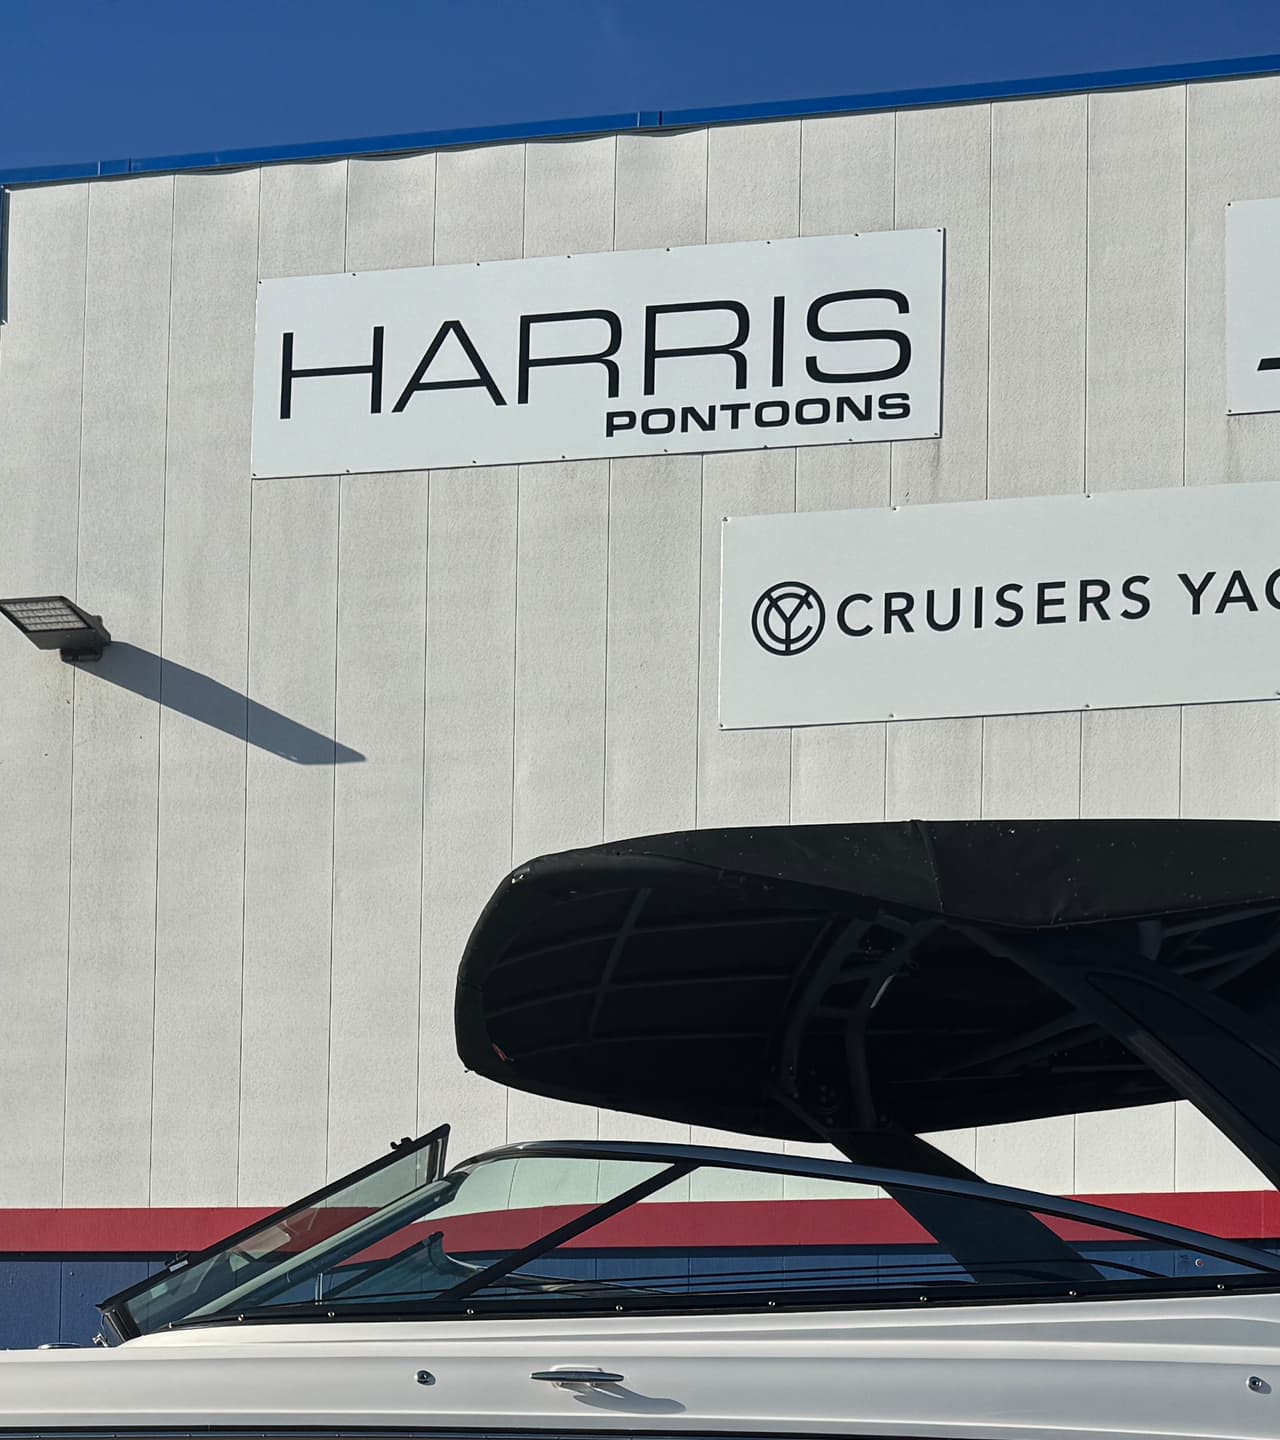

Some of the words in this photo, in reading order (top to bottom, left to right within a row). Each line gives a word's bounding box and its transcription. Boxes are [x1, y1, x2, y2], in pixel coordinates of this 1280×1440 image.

[279, 288, 912, 420] HARRIS
[605, 392, 911, 438] PONTOONS
[836, 575, 1151, 637] CRUISERS
